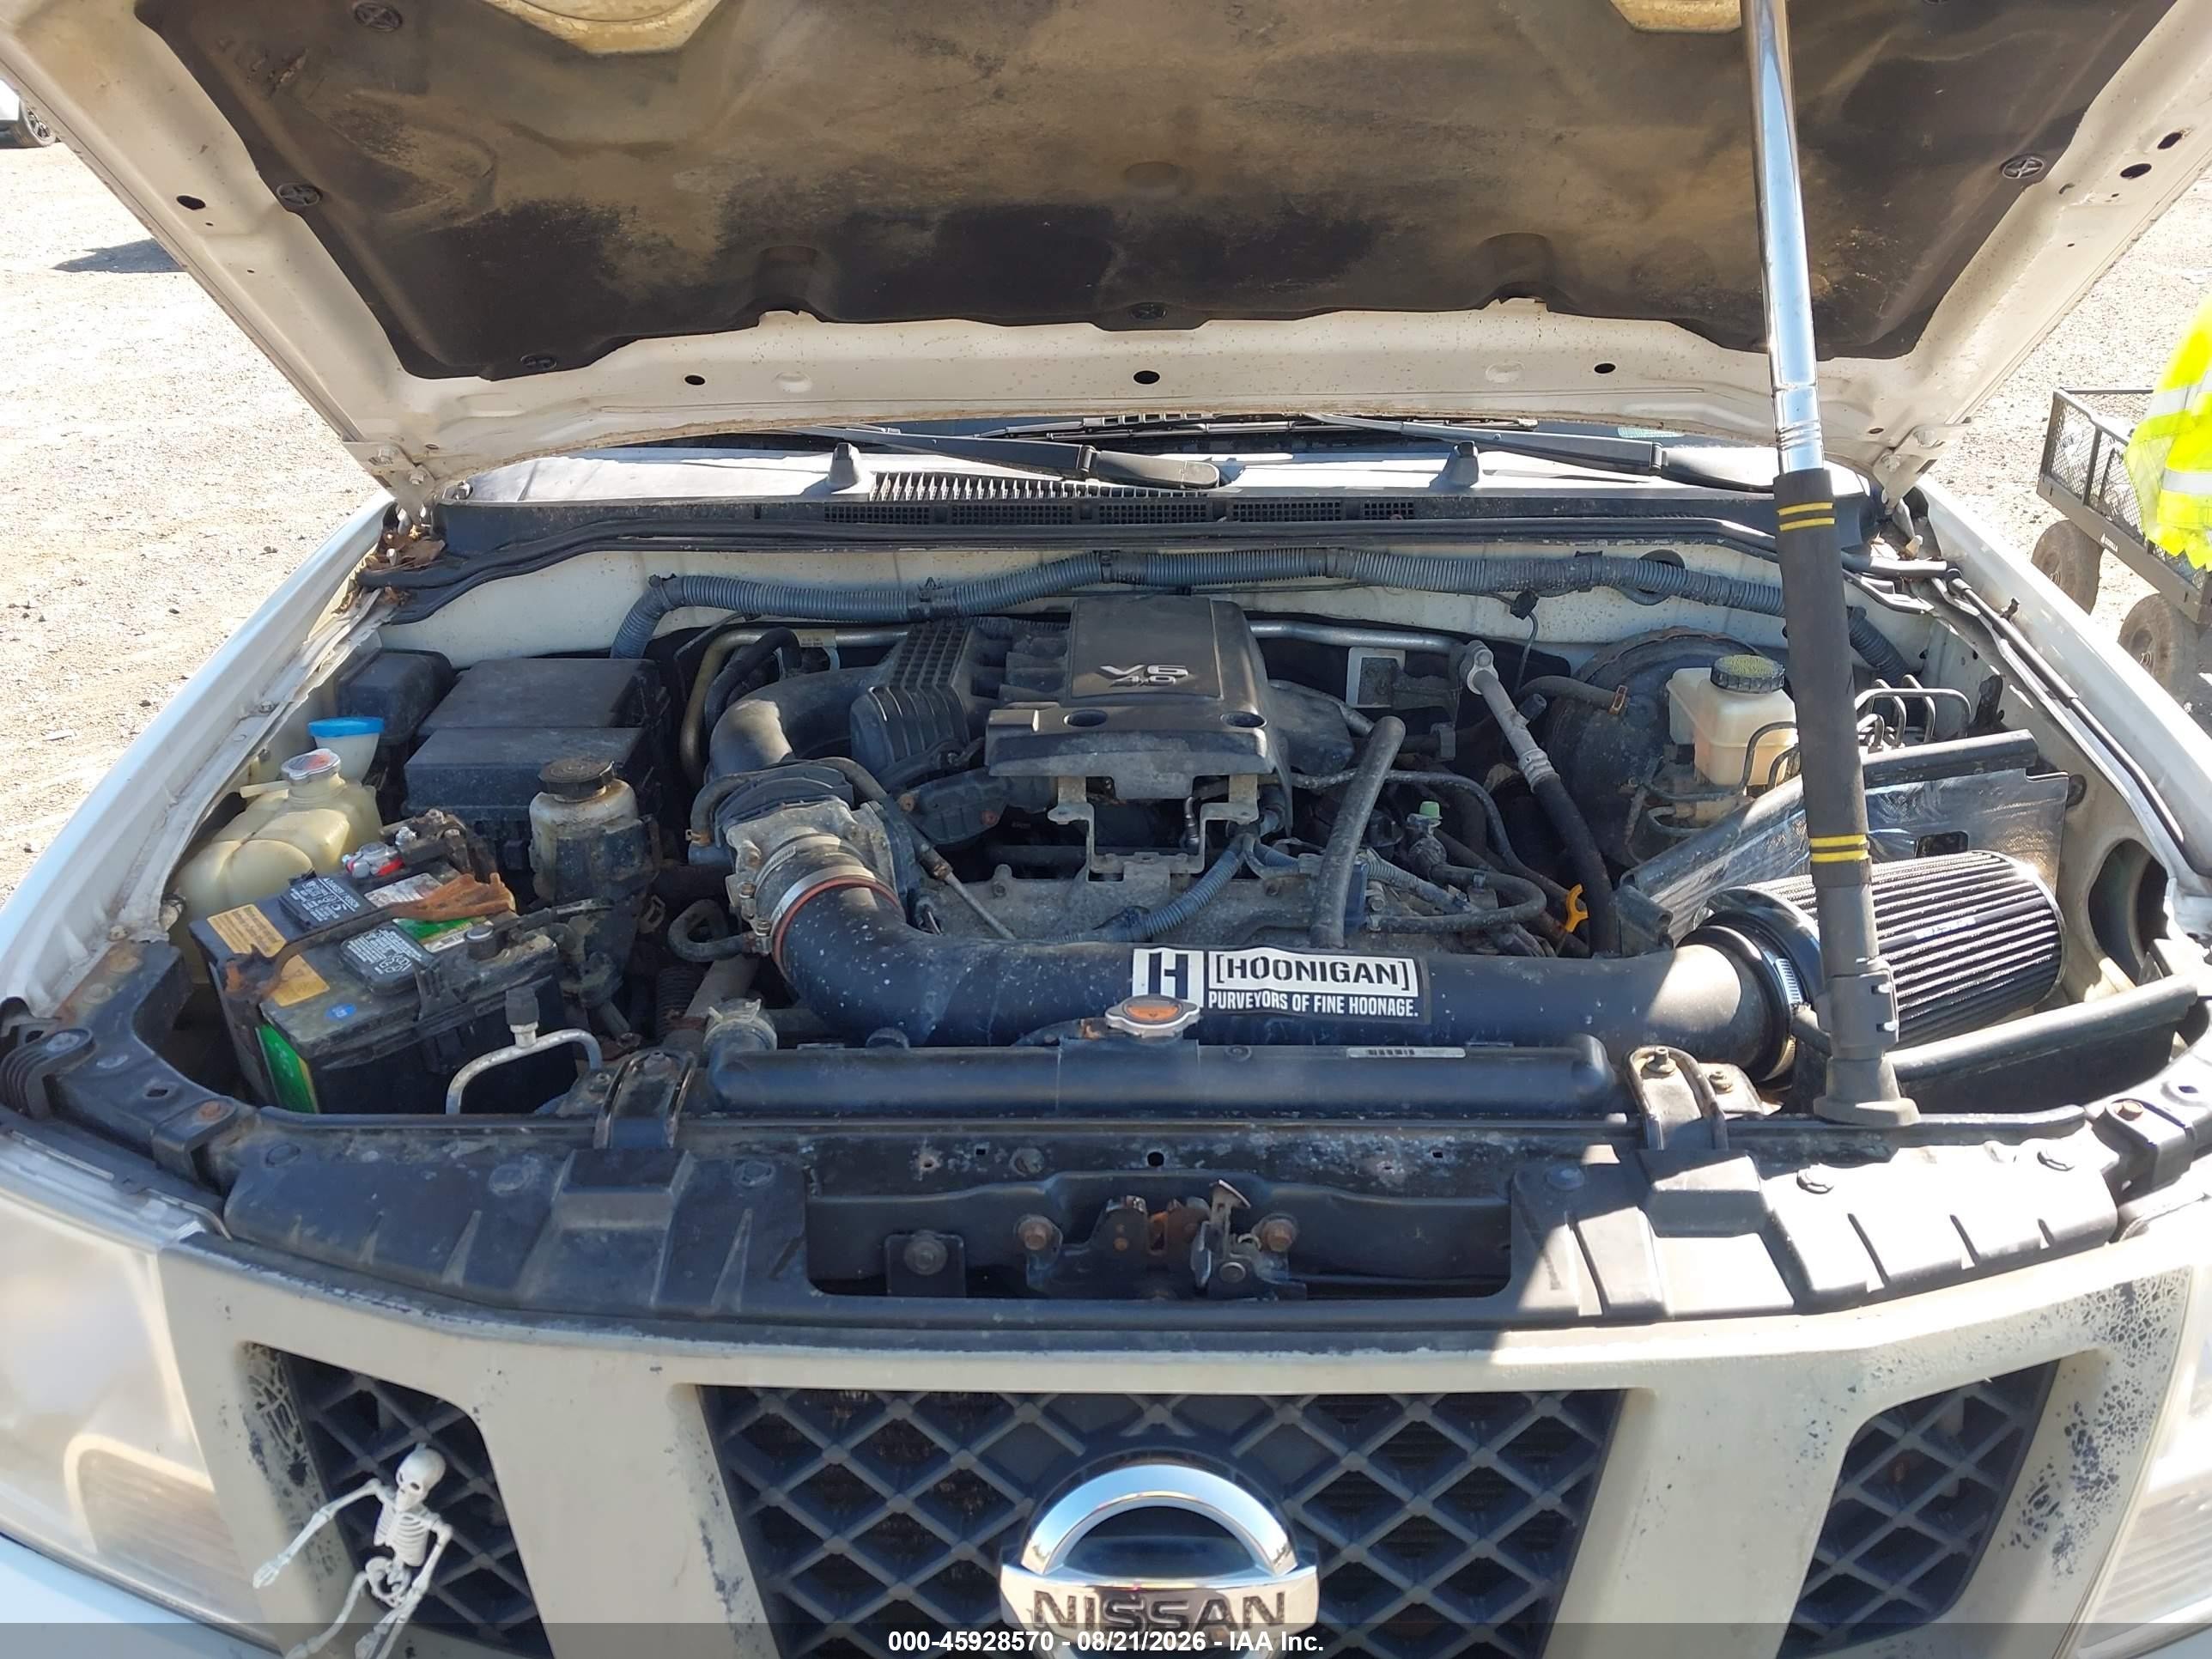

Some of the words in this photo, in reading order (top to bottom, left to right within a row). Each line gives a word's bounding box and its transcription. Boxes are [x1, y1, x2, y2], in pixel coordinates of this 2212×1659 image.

[1100, 665, 1188, 677] V6
[1208, 990, 1288, 1010] PURVEYORS
[1291, 994, 1310, 1012] OF
[1314, 994, 1346, 1014] FINE
[1348, 997, 1419, 1017] HOONAGE.
[1033, 1589, 1286, 1634] NISSAN
